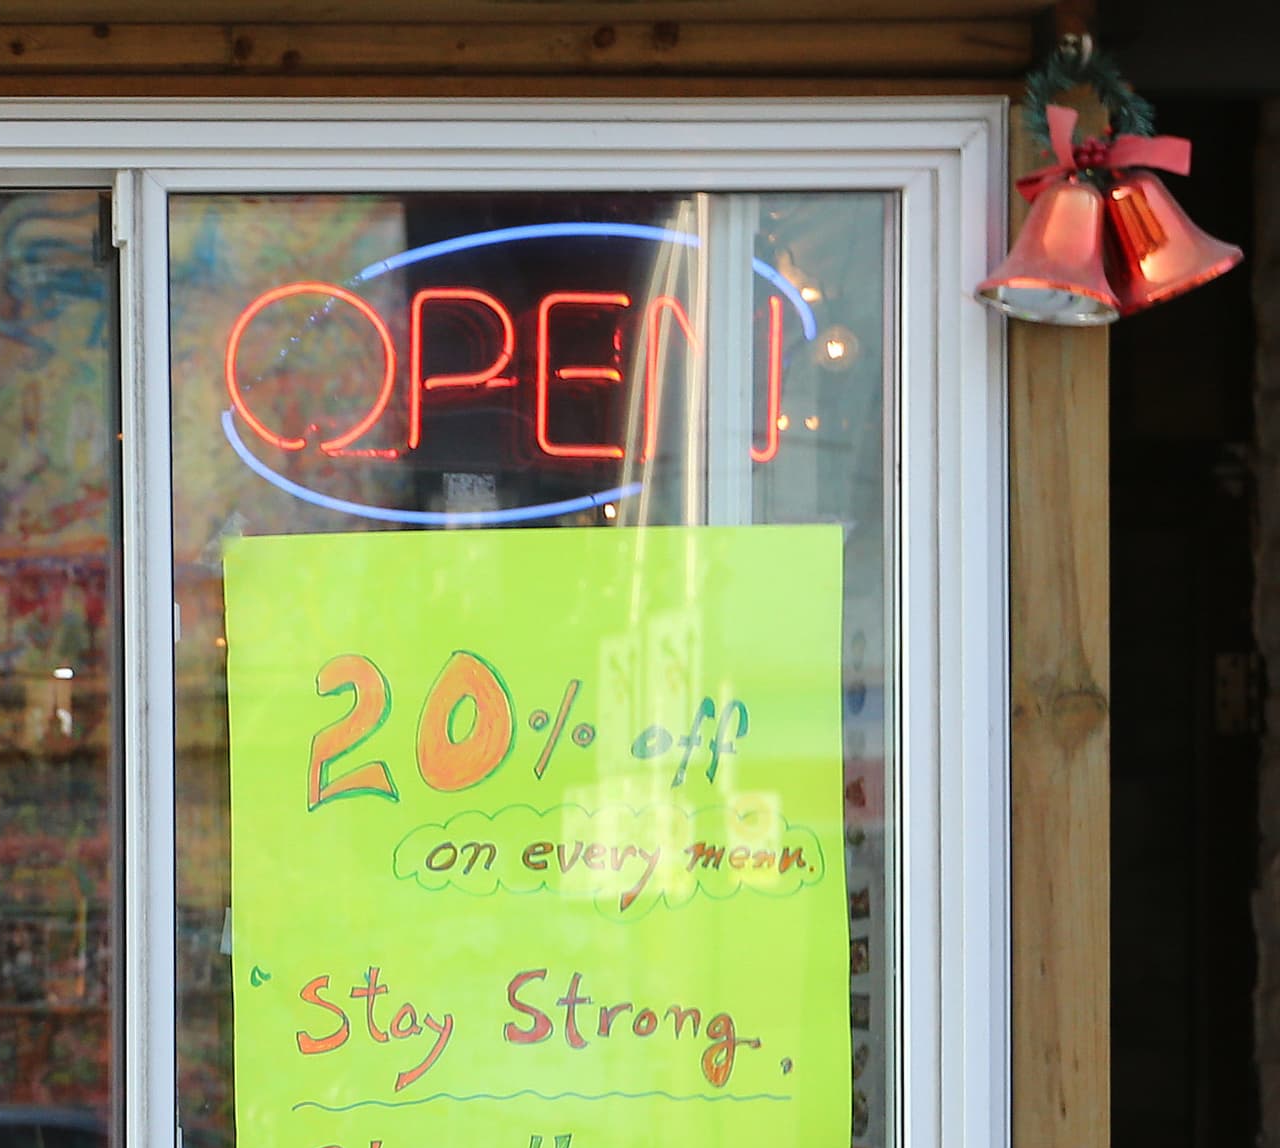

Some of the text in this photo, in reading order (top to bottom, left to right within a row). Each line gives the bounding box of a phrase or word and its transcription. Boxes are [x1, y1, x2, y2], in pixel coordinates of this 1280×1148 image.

[225, 281, 783, 464] OPEN
[308, 650, 748, 813] 20% off
[426, 842, 497, 875] on
[521, 841, 662, 912] every
[296, 966, 454, 1091] Stay
